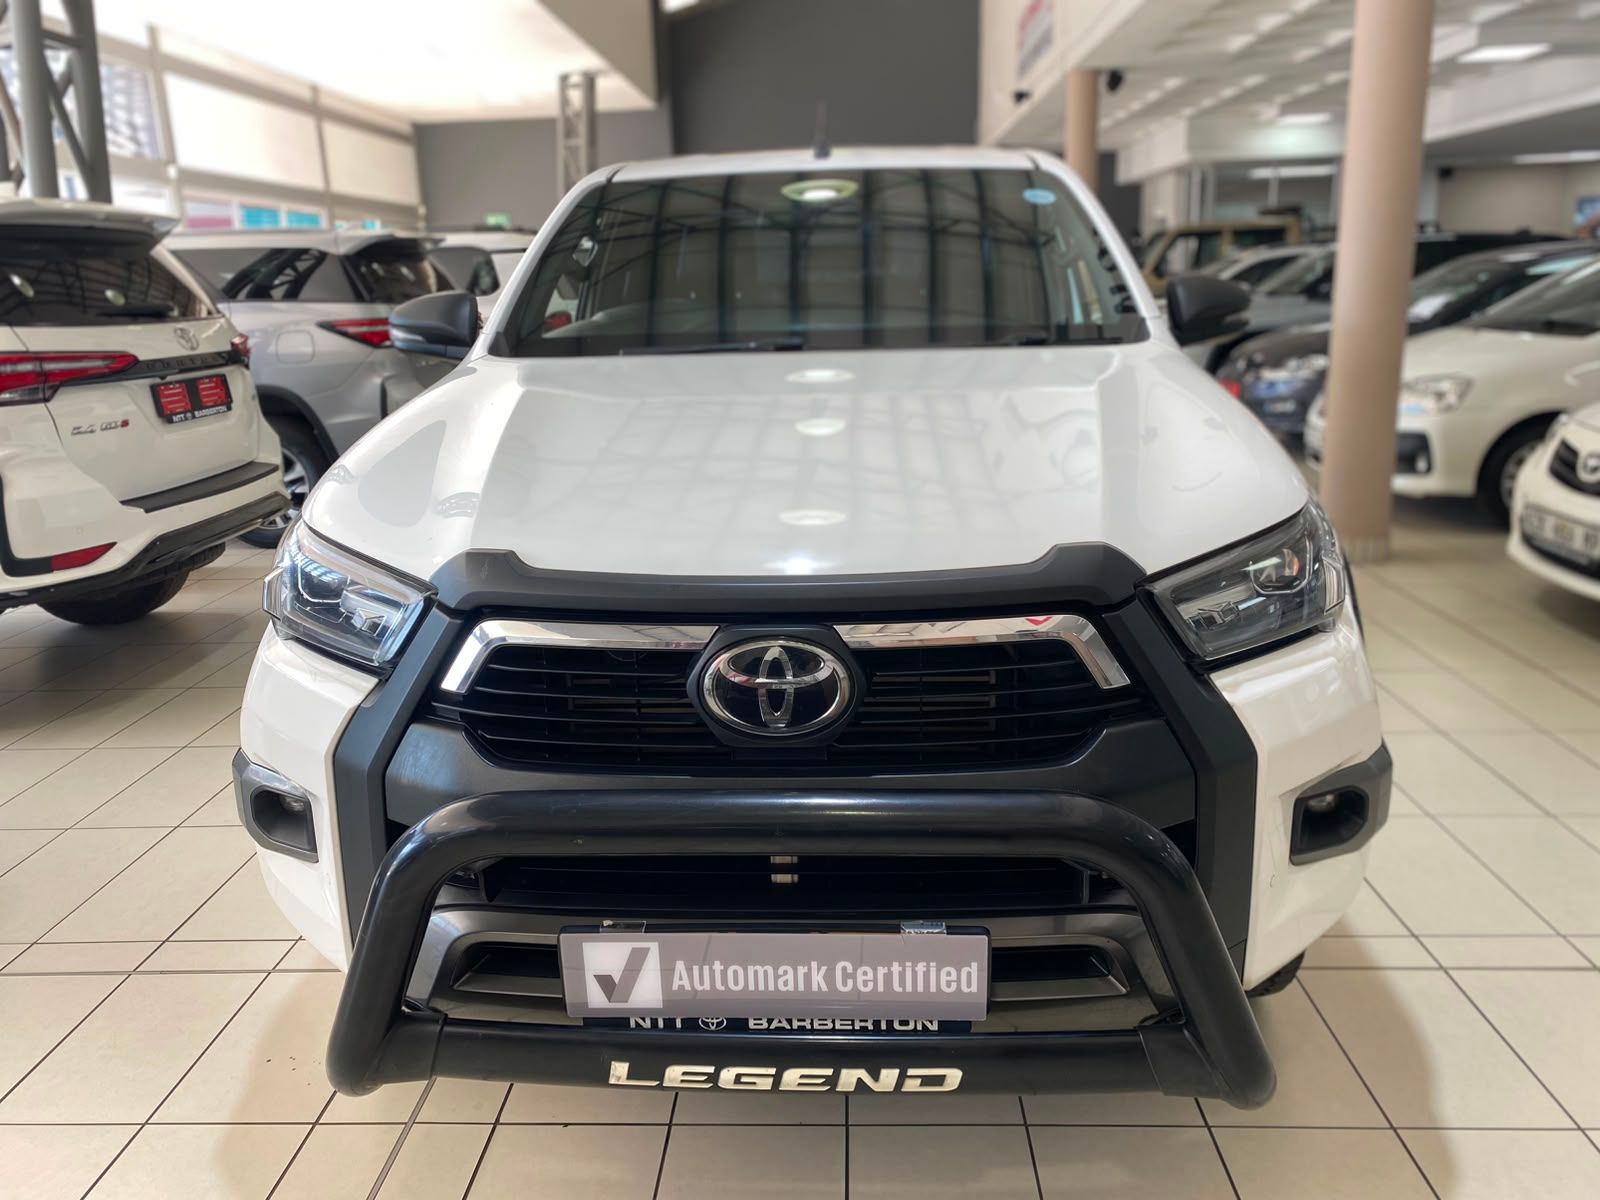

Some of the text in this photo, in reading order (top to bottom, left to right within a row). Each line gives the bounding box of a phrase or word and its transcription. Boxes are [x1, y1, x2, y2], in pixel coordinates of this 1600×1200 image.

[672, 960, 979, 993] Automark Certified
[748, 1016, 939, 1032] BARBERTON
[608, 1061, 963, 1092] LEGEND
